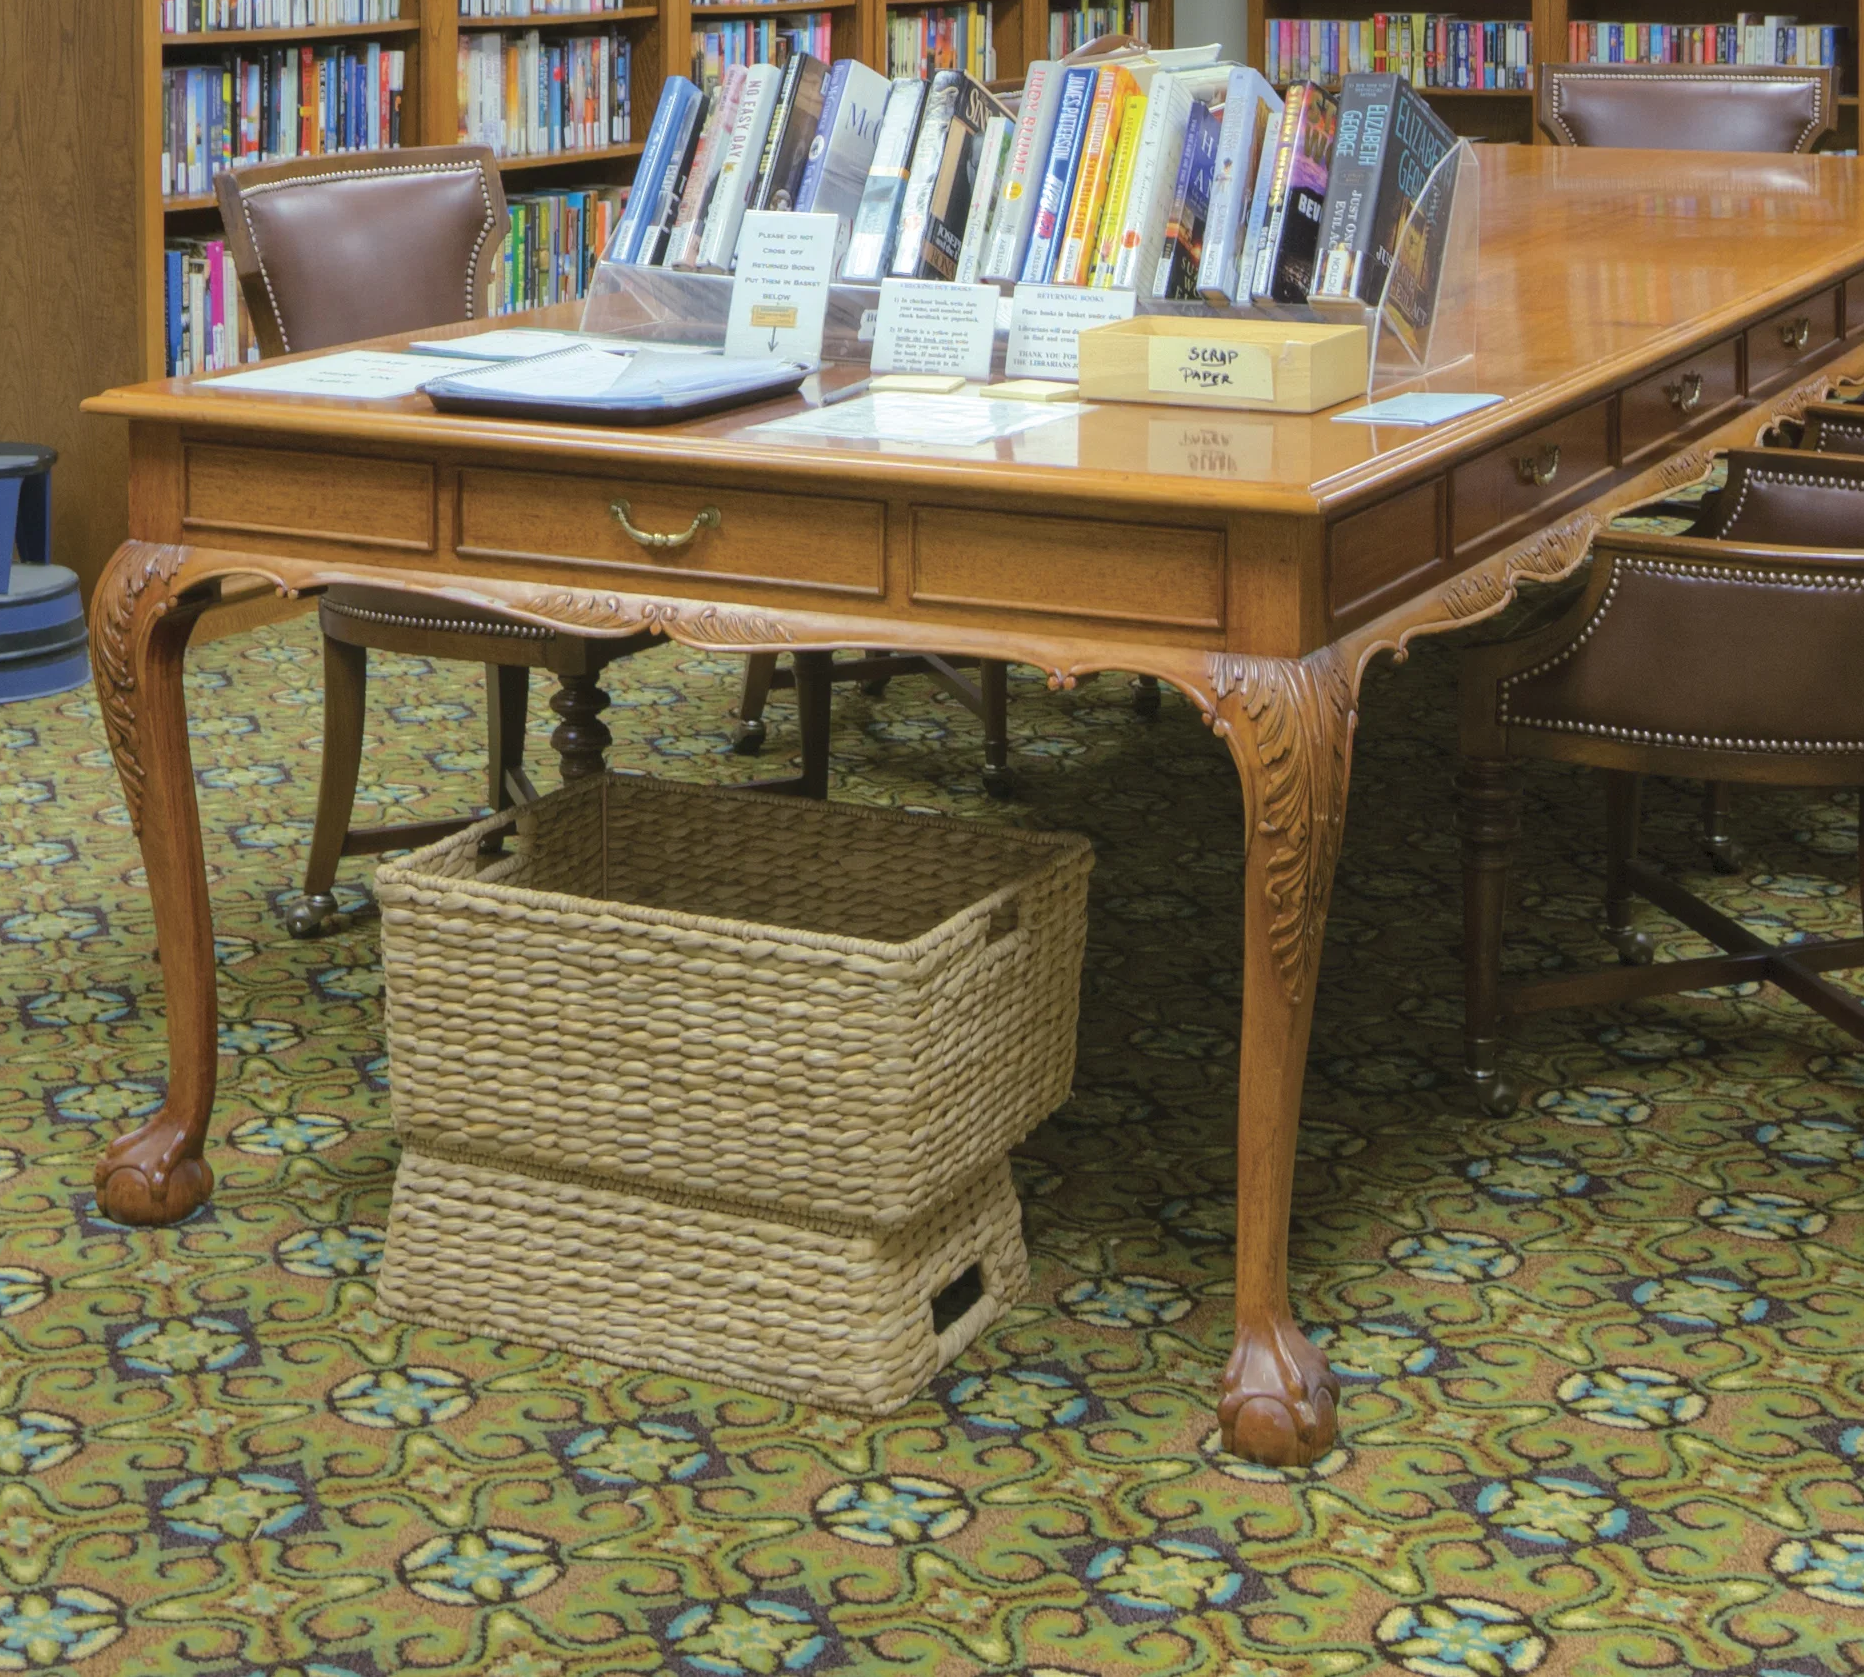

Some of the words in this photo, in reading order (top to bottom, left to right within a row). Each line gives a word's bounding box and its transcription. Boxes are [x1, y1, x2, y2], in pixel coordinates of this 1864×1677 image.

[747, 81, 761, 95] NO
[1026, 68, 1047, 112] JUDY
[1064, 74, 1085, 106] JAMES
[1098, 71, 1115, 99] JANET
[737, 101, 756, 130] EASY
[1087, 103, 1107, 154] EVANOVICH
[729, 136, 744, 157] DAY
[1011, 117, 1036, 175] BLUME
[1051, 108, 1079, 160] PATTERSON
[1336, 110, 1362, 157] GEORGE
[1358, 104, 1388, 166] ELIZABETH
[1078, 157, 1097, 210] EXPLOSIVE
[1348, 189, 1362, 221] JUST
[1072, 212, 1084, 239] EIGHT
[1342, 224, 1355, 249] ONE
[1203, 250, 1216, 284] FICTION
[1327, 257, 1342, 292] FICTION
[1030, 360, 1071, 368] LIBRARIANS
[1188, 347, 1238, 364] SCRAP
[1179, 367, 1233, 384] PAPER
